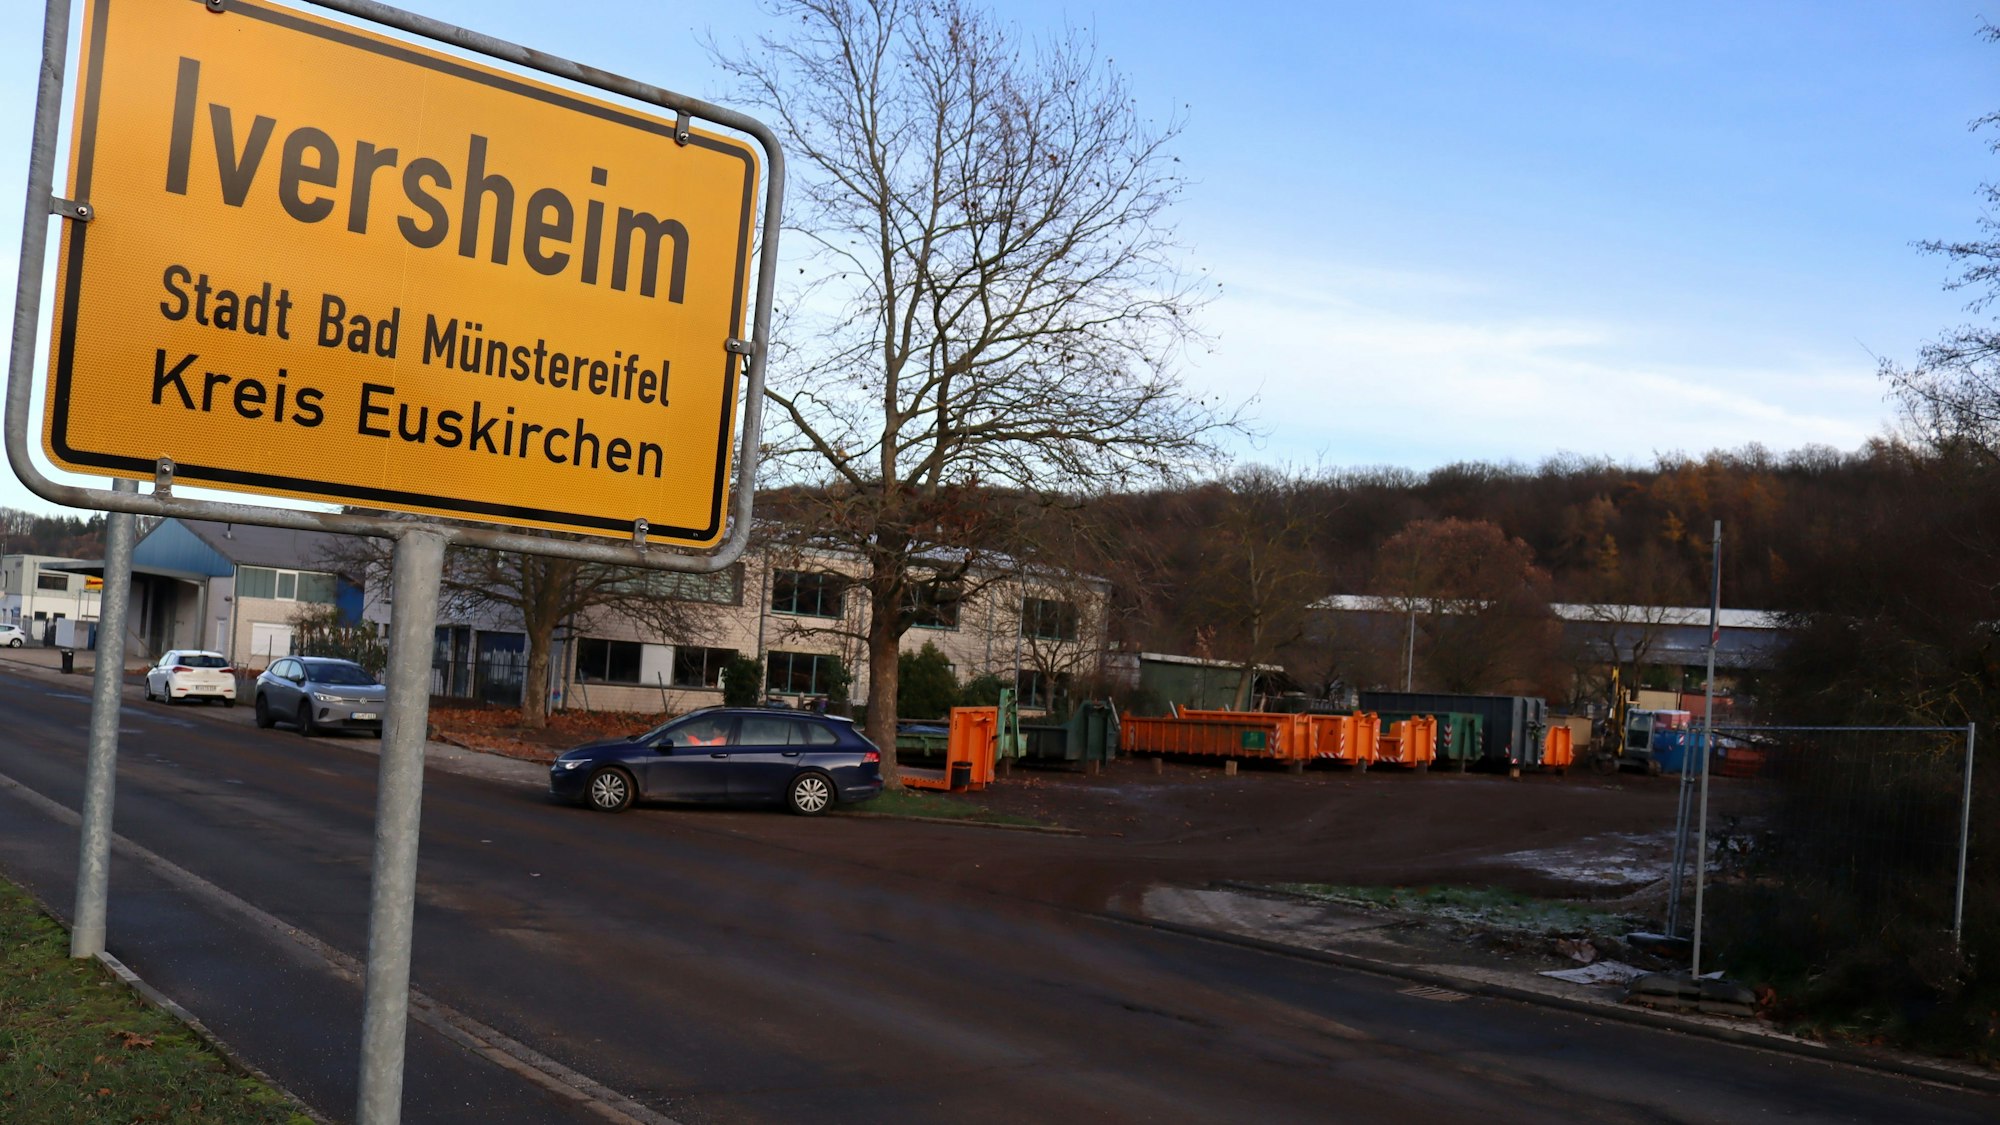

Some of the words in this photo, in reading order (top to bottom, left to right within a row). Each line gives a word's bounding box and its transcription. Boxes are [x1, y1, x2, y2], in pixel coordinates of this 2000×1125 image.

[165, 57, 689, 304] Iversheim
[160, 264, 292, 340] Stadt
[318, 294, 400, 359] Bad
[422, 314, 670, 407] Münstereifel
[151, 349, 325, 428] Kreis
[357, 383, 664, 478] Euskirchen
